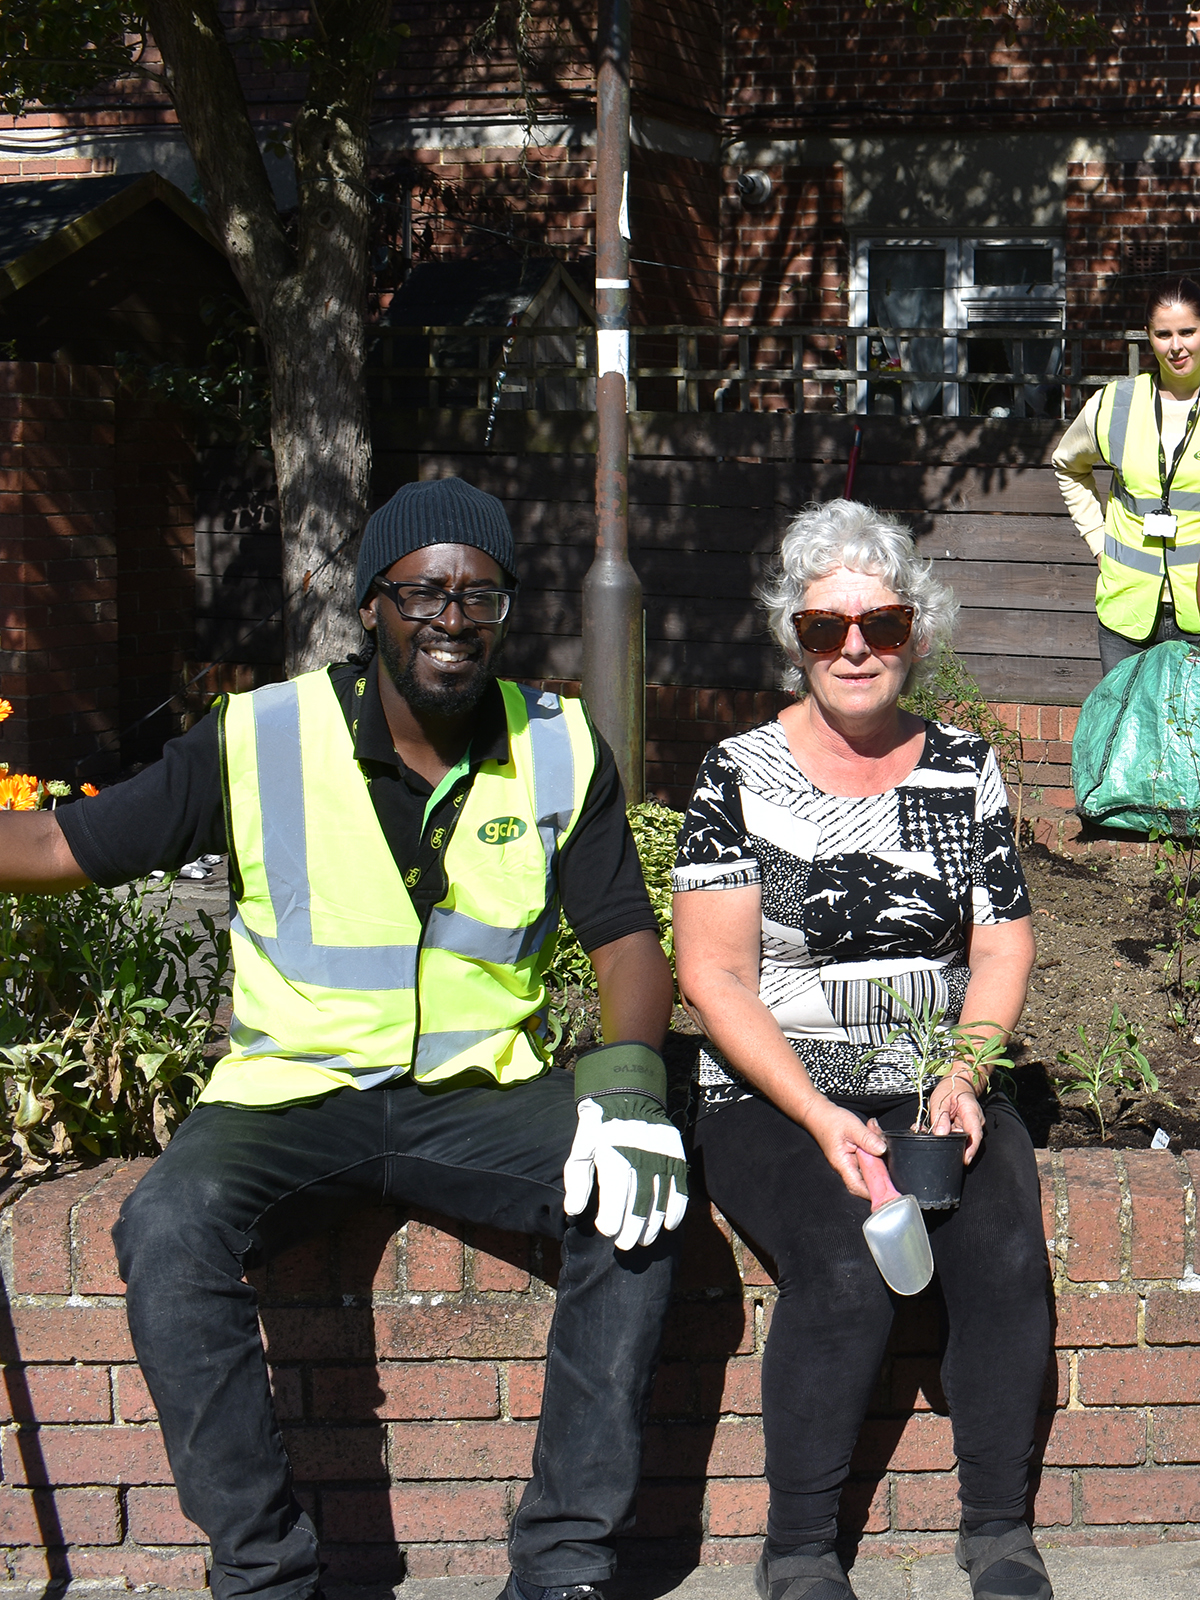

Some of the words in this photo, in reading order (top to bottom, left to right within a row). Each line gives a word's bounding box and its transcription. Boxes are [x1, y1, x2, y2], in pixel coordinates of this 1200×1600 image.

[432, 826, 446, 846] gch
[485, 818, 520, 844] gch
[406, 867, 420, 885] gch
